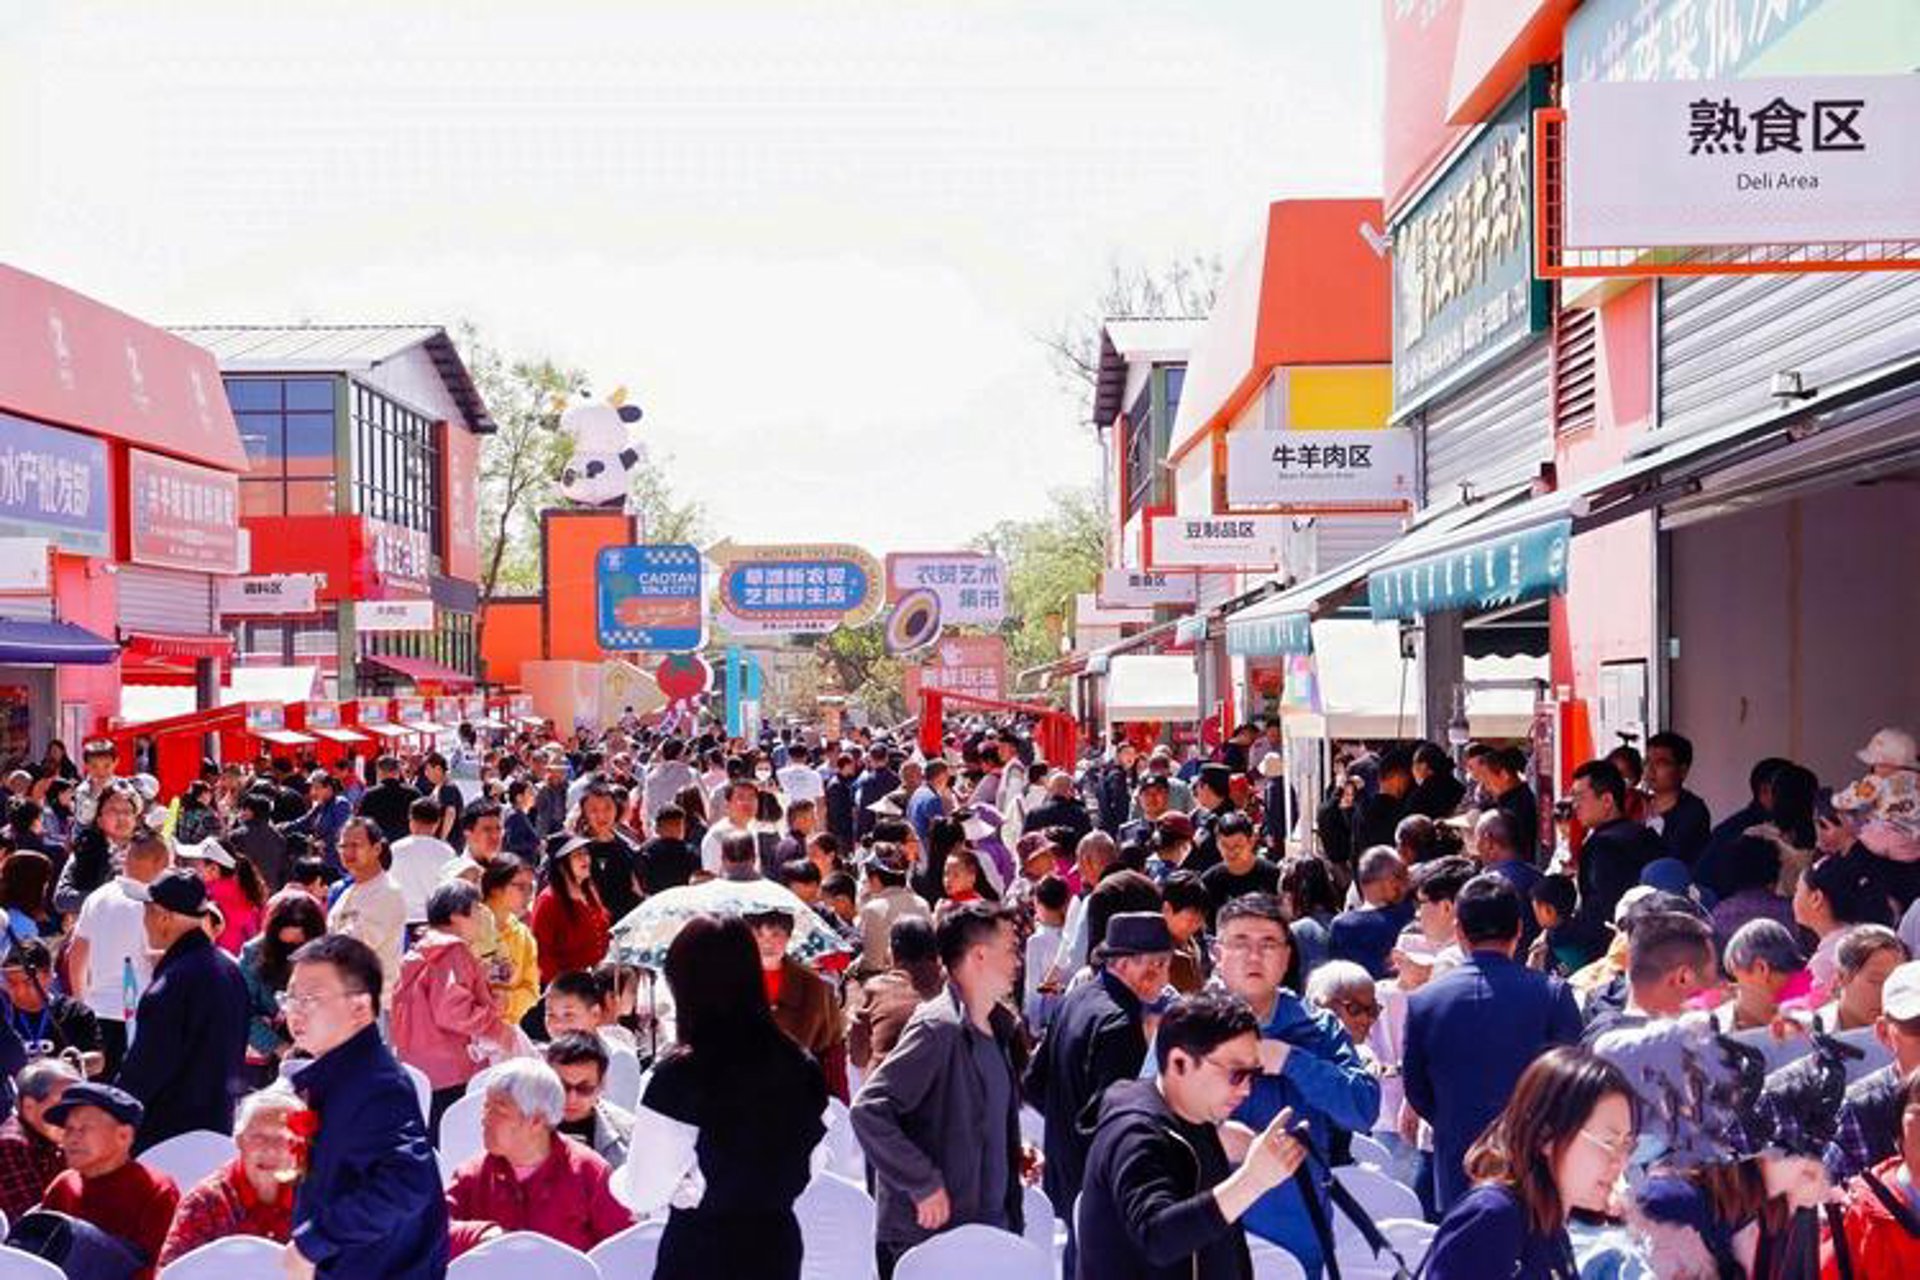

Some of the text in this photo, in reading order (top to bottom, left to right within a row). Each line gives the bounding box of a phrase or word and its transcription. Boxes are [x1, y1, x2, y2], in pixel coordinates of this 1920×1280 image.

[1688, 97, 1866, 155] 熟食区
[1737, 172, 1819, 190] Deli Area
[1272, 443, 1373, 469] 牛羊肉区
[1186, 521, 1255, 539] 豆制品区
[639, 573, 697, 585] CAOTAN
[917, 565, 998, 584] 农贸艺术
[959, 589, 1000, 609] 集市
